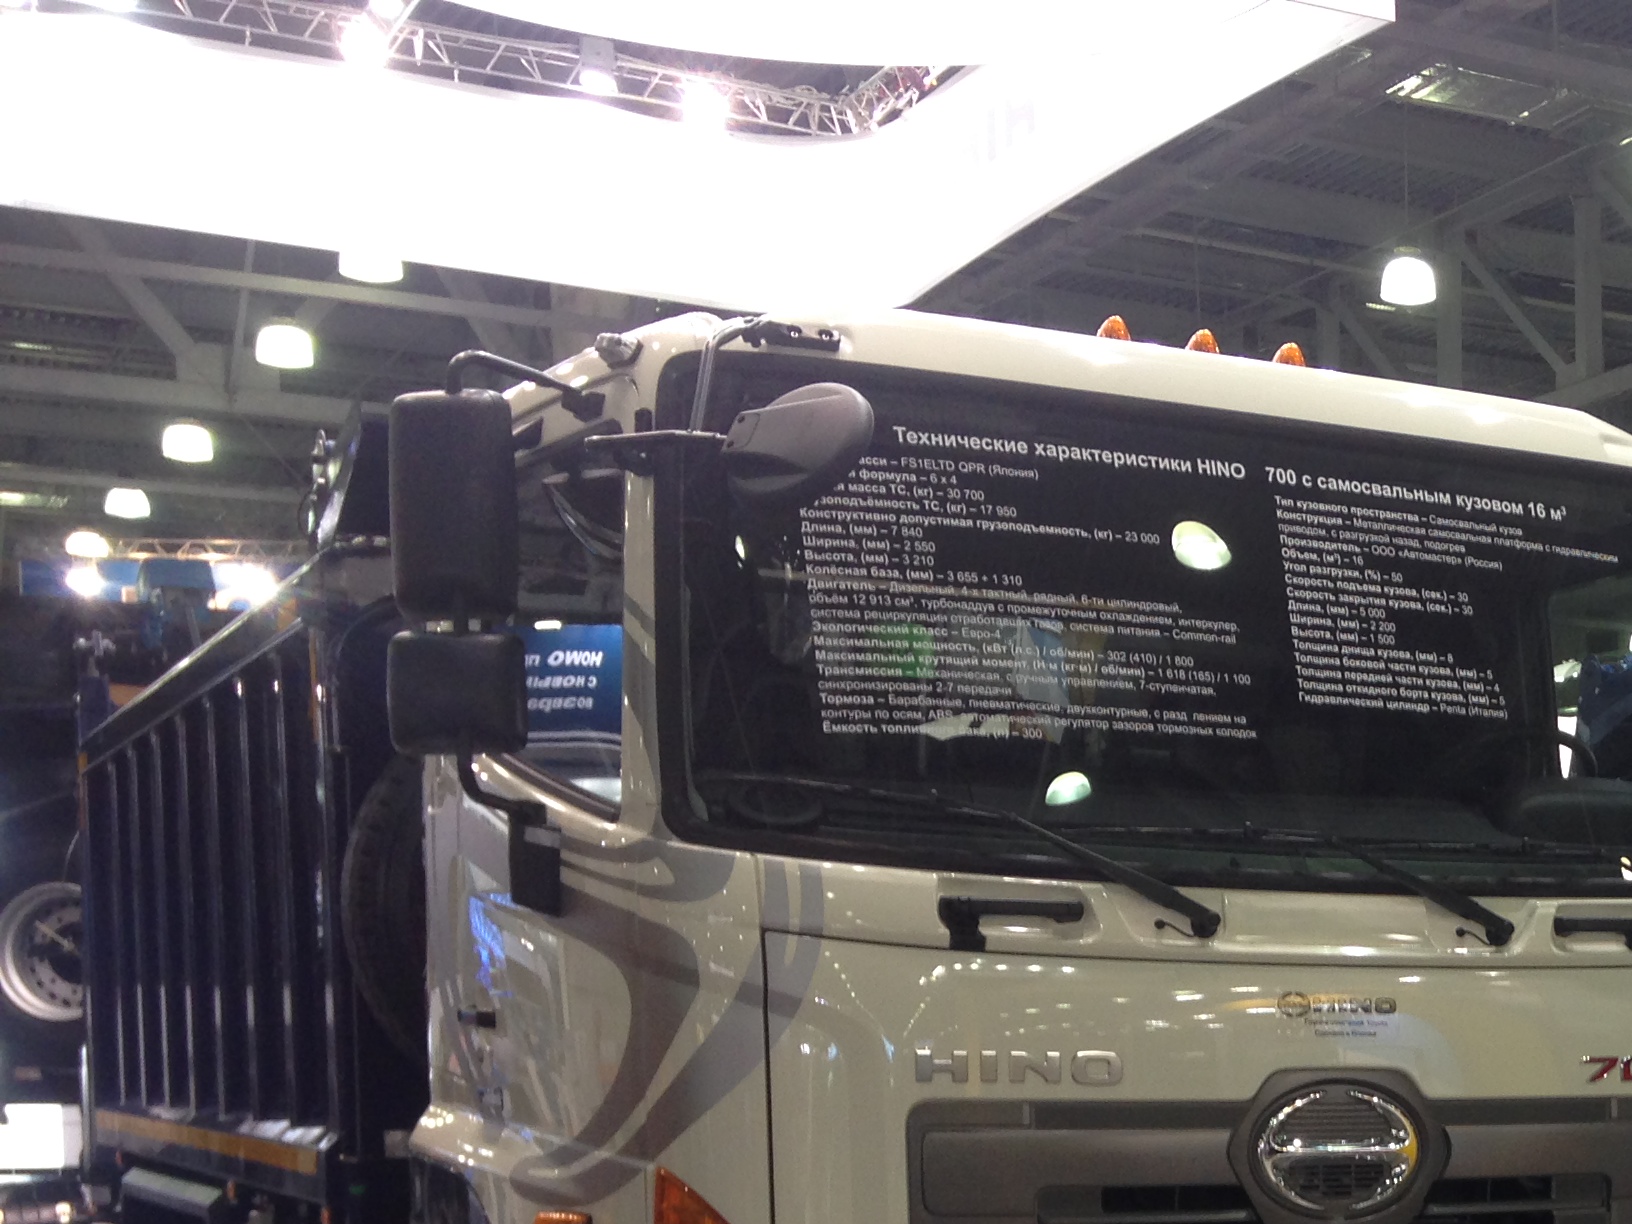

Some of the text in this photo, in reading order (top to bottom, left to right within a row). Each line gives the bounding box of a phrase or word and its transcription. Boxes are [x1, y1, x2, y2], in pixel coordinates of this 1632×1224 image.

[893, 427, 1027, 455] Технические
[1034, 445, 1191, 473] характеристики
[1197, 459, 1245, 479] HINO
[1265, 467, 1295, 485] 700
[1302, 474, 1311, 487] с
[1317, 476, 1450, 504] самосвальным
[1456, 494, 1523, 514] кузовом
[1527, 501, 1545, 518] 16
[901, 458, 954, 471] FS1ELTD
[958, 462, 985, 474] QPR
[988, 464, 1038, 480] (Япония)
[859, 470, 915, 483] формула
[848, 484, 984, 500] масса (кг) 30 700
[1275, 495, 1293, 506] Тип
[946, 502, 966, 514] (кг)
[799, 507, 1159, 544] Конструктивно допустимая (кг) 23 000
[801, 522, 922, 537] Длина, (мм) 840
[802, 536, 935, 552] Ширина, (мм) 550
[1279, 534, 1360, 552] Производитель
[1371, 544, 1395, 556] ООО
[804, 550, 933, 566] Высота, (мм) 210
[1282, 560, 1306, 571] Угол
[870, 567, 902, 579] база,
[906, 568, 933, 581] (мм)
[957, 572, 977, 583] 655
[1001, 575, 1021, 585] 310
[1284, 574, 1333, 588] Скорость
[807, 577, 875, 591] Двигатель
[852, 594, 865, 604] 12
[869, 595, 890, 605] 913
[1286, 587, 1335, 601] Скорость
[1368, 608, 1385, 619] 000
[810, 608, 860, 618] система
[1069, 623, 1113, 633] система
[1172, 629, 1236, 644] Common-rail
[812, 621, 909, 634] Экологический
[912, 627, 947, 635] класс
[1379, 621, 1395, 632] 200
[813, 636, 909, 649] Максимальная
[912, 641, 978, 653] мощность,
[1107, 650, 1125, 661] 302
[1129, 652, 1156, 665] (410)
[1174, 655, 1193, 666] 800
[815, 649, 1250, 684] Максимальный крутящий (165) 100
[816, 664, 902, 676] Трансмиссия
[818, 680, 932, 692] синхронизированы
[819, 693, 873, 705] Тормоза
[820, 710, 871, 720] контуры
[874, 711, 889, 719] по
[1022, 728, 1042, 738] 300
[914, 1048, 1124, 1086] HINO
